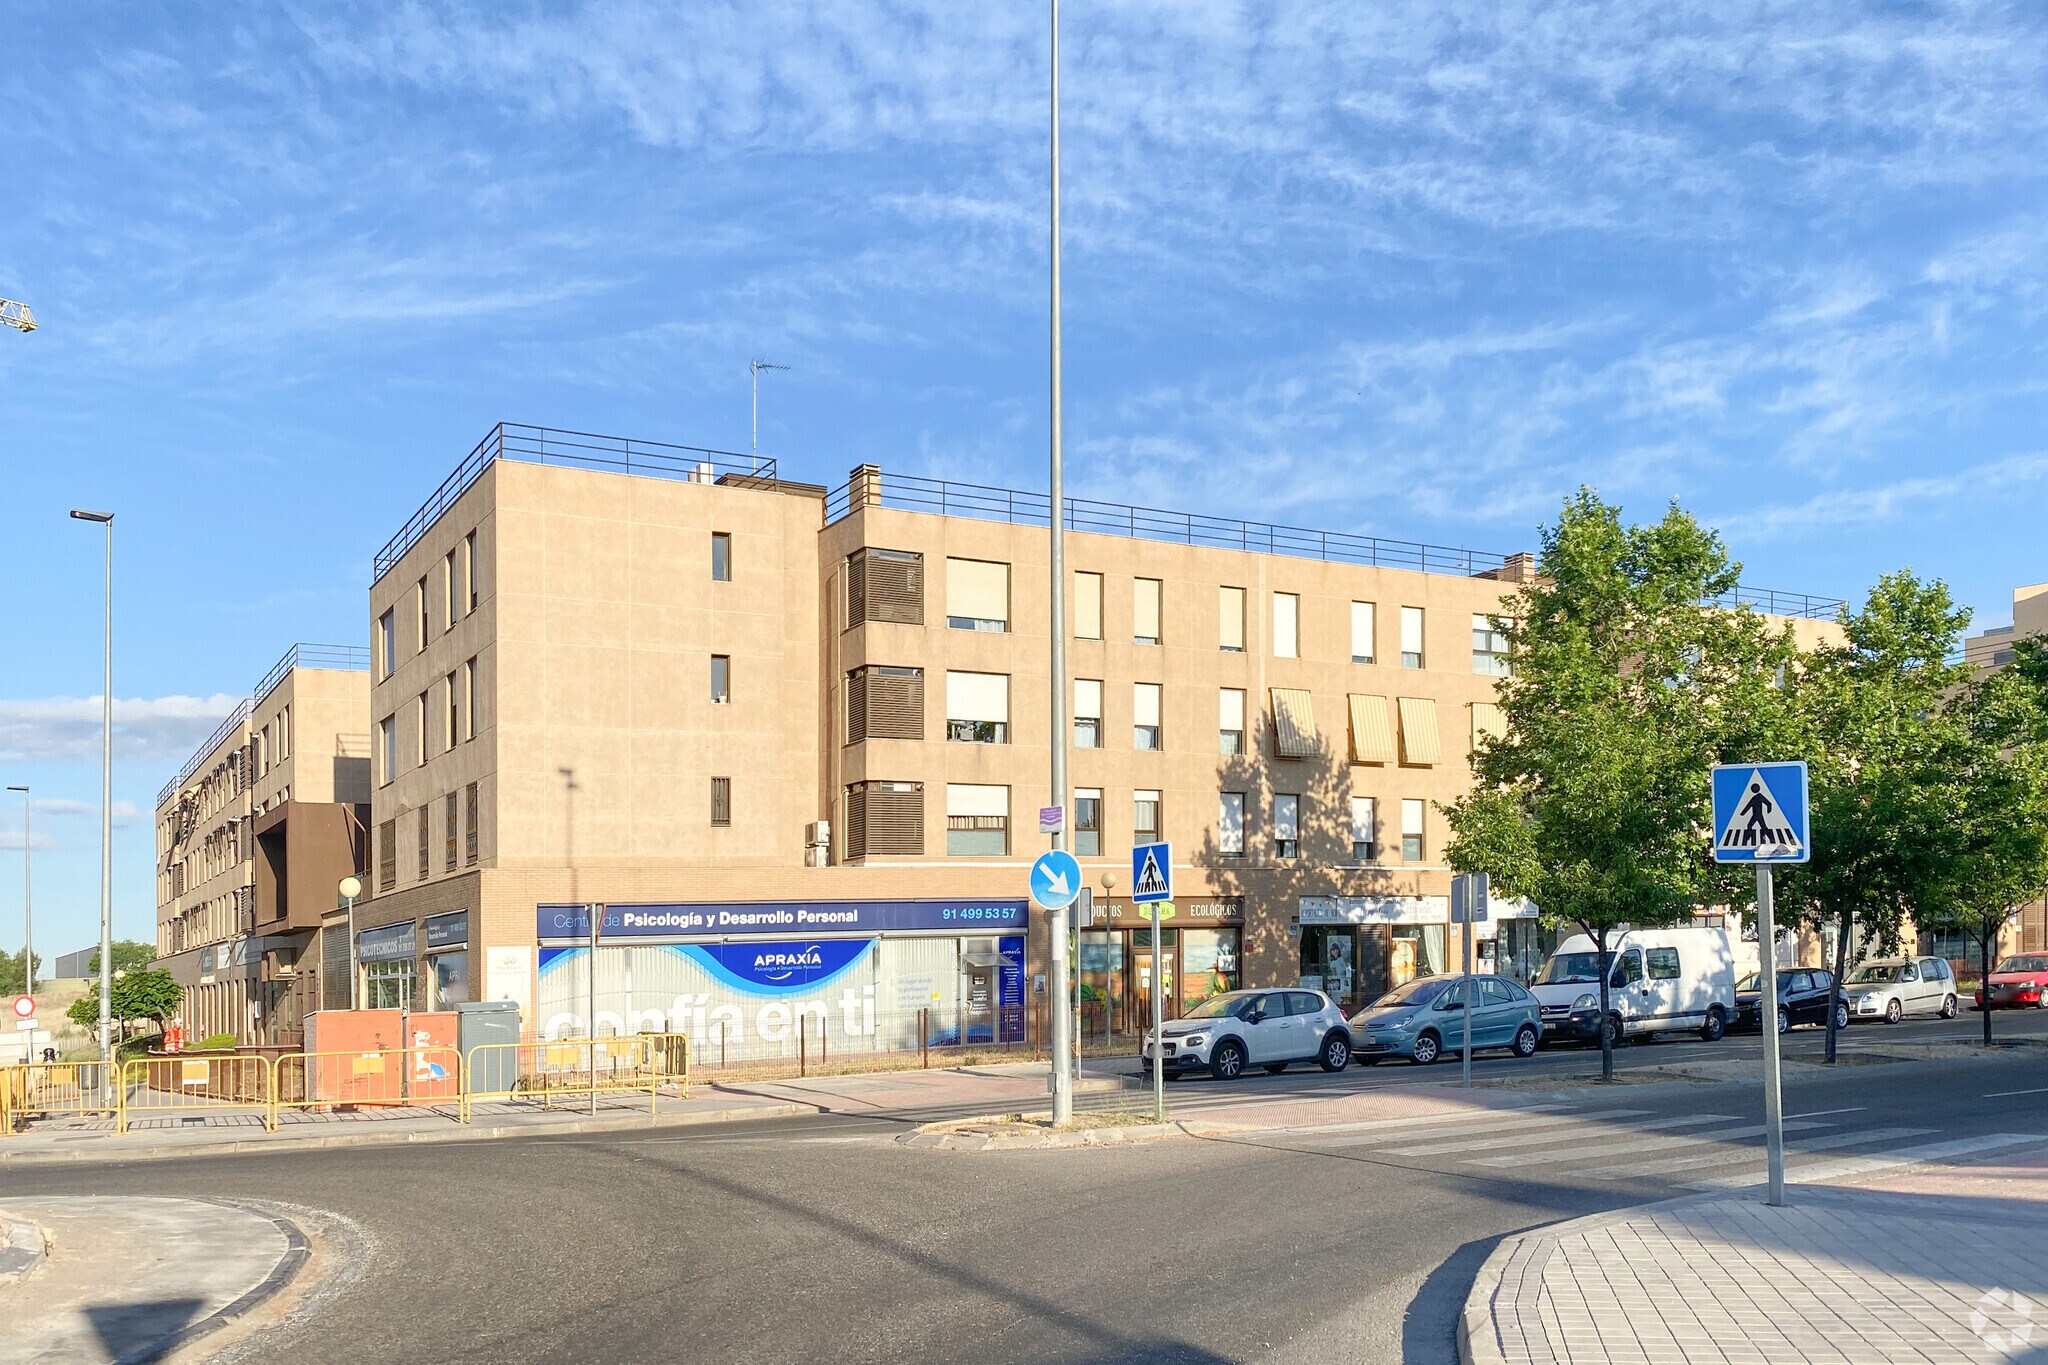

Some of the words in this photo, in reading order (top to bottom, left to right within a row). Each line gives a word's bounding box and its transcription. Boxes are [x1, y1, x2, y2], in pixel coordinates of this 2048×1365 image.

[554, 914, 590, 928] Cent
[602, 914, 620, 927] de
[623, 911, 703, 929] Psicología
[706, 913, 716, 928] y
[719, 910, 794, 925] Desarrollo
[797, 909, 858, 924] Personal
[942, 908, 957, 920] 91
[960, 908, 983, 919] 499
[985, 908, 1000, 919] 53
[1002, 908, 1017, 919] 57
[1190, 902, 1237, 918] ECOLÓGICOS
[755, 1000, 828, 1042] en
[838, 985, 875, 1036] ti
